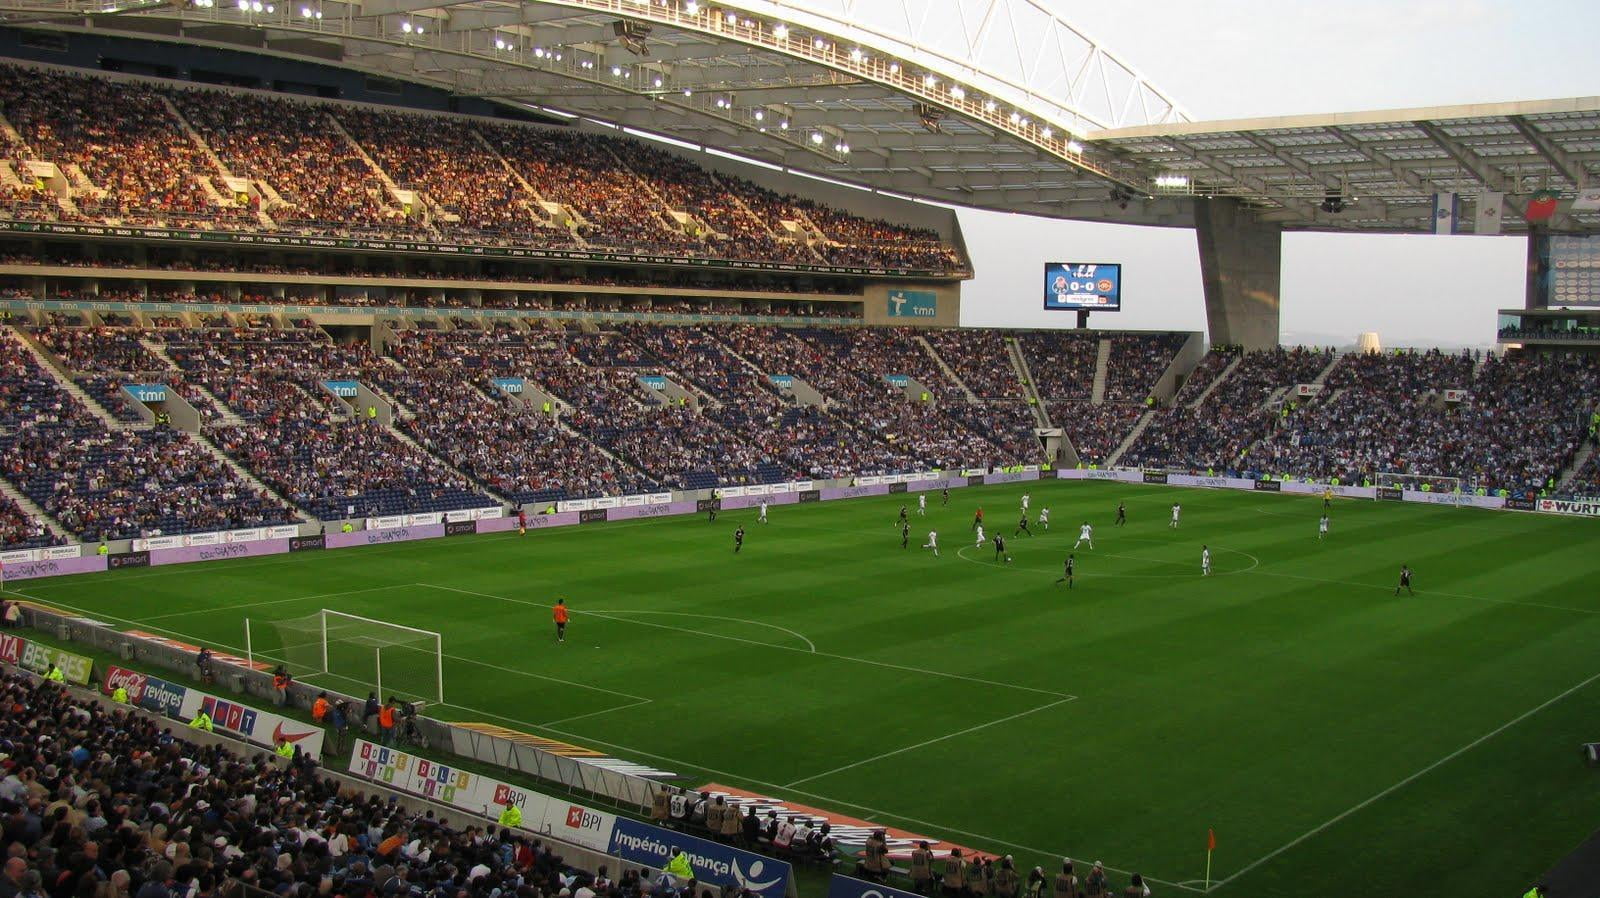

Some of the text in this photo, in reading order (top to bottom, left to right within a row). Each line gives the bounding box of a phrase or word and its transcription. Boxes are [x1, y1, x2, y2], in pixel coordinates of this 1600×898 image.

[913, 306, 935, 316] tmn
[139, 390, 166, 401] tmn
[333, 385, 358, 397] tmn
[501, 383, 522, 393] tmn
[123, 554, 147, 565] smart
[23, 643, 52, 671] BES
[362, 745, 407, 769] DOLCE
[419, 762, 466, 787] DOLCE
[509, 791, 527, 808] BPI
[582, 812, 602, 831] BPI
[614, 829, 667, 857] Império
